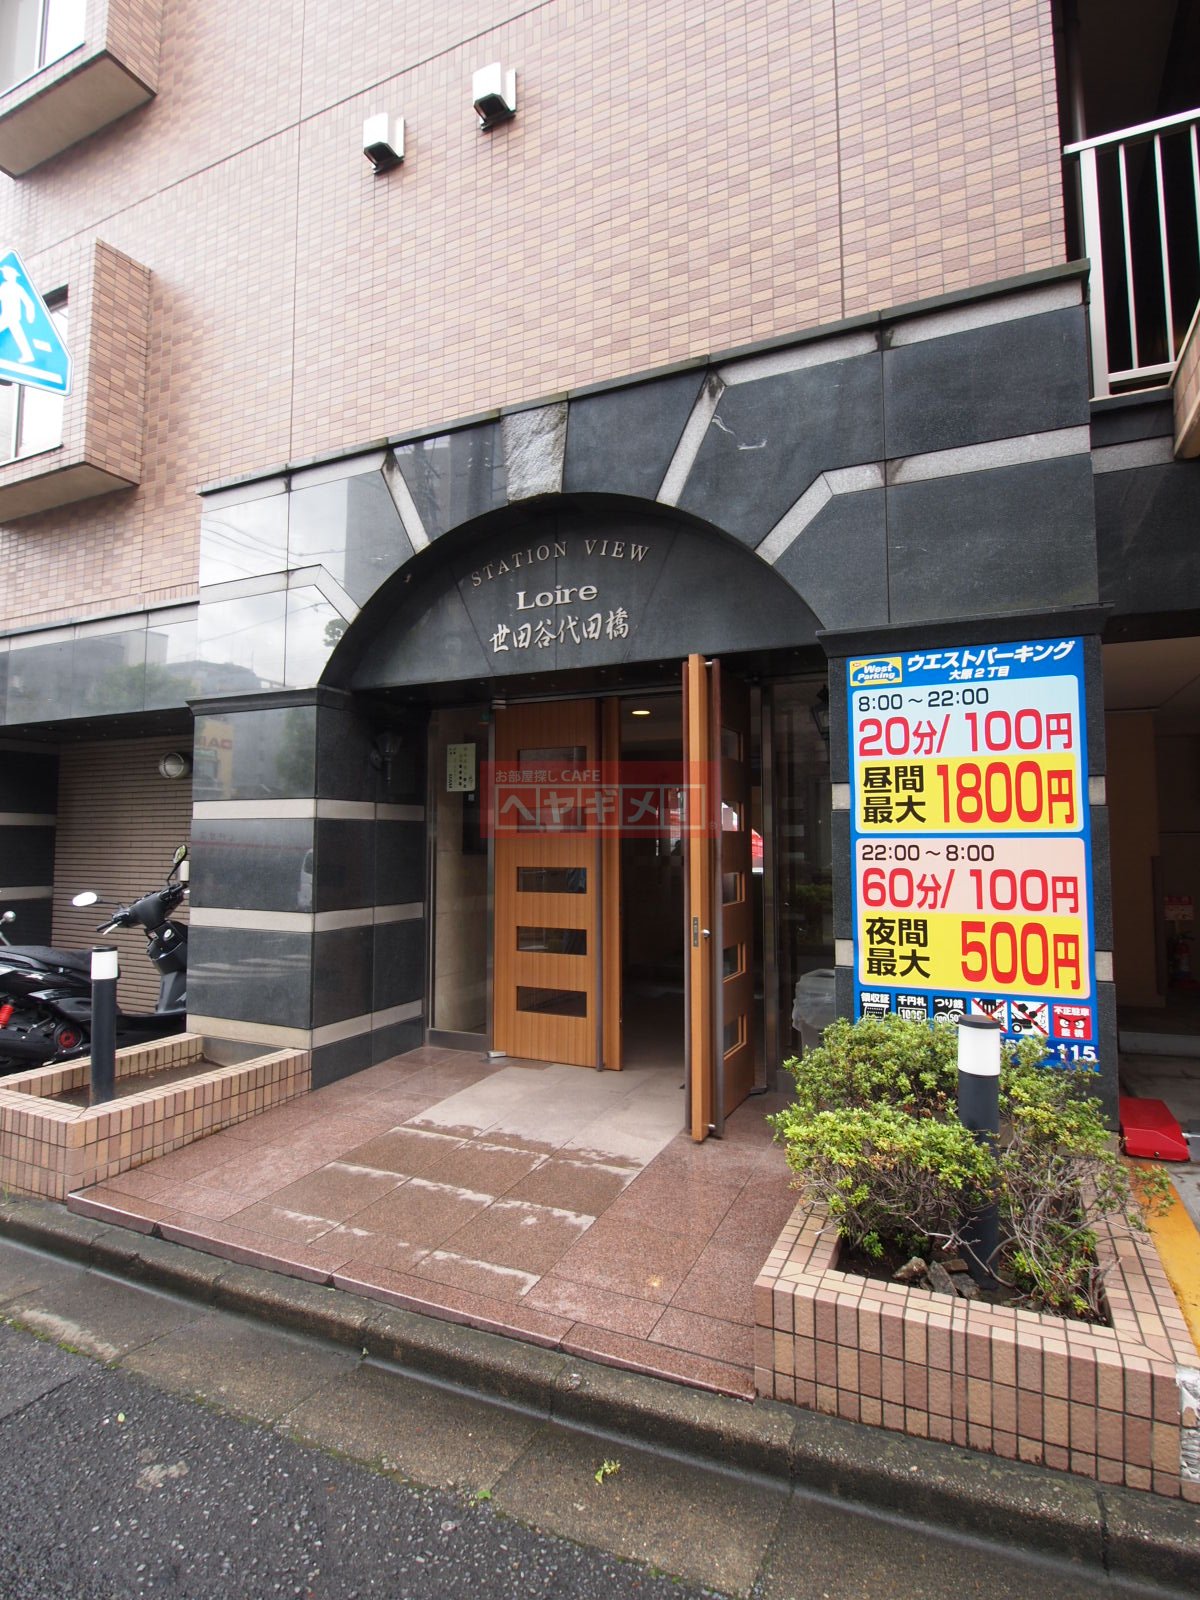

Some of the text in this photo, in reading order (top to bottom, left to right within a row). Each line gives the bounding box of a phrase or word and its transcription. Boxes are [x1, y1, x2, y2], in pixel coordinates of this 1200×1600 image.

[471, 539, 649, 587] STATION VIEW
[516, 585, 598, 610] Loire
[489, 606, 629, 653] 世田谷代田橋
[864, 663, 893, 674] West
[907, 641, 1075, 672] ウエストパーキング
[857, 672, 895, 681] Parking
[863, 765, 924, 793] 昼間
[937, 761, 1074, 824] 1800円
[863, 795, 926, 824] 最大
[866, 917, 928, 947] 夜間
[867, 948, 930, 979] 最大
[961, 920, 1081, 989] 500円
[897, 995, 926, 1007] 千円札
